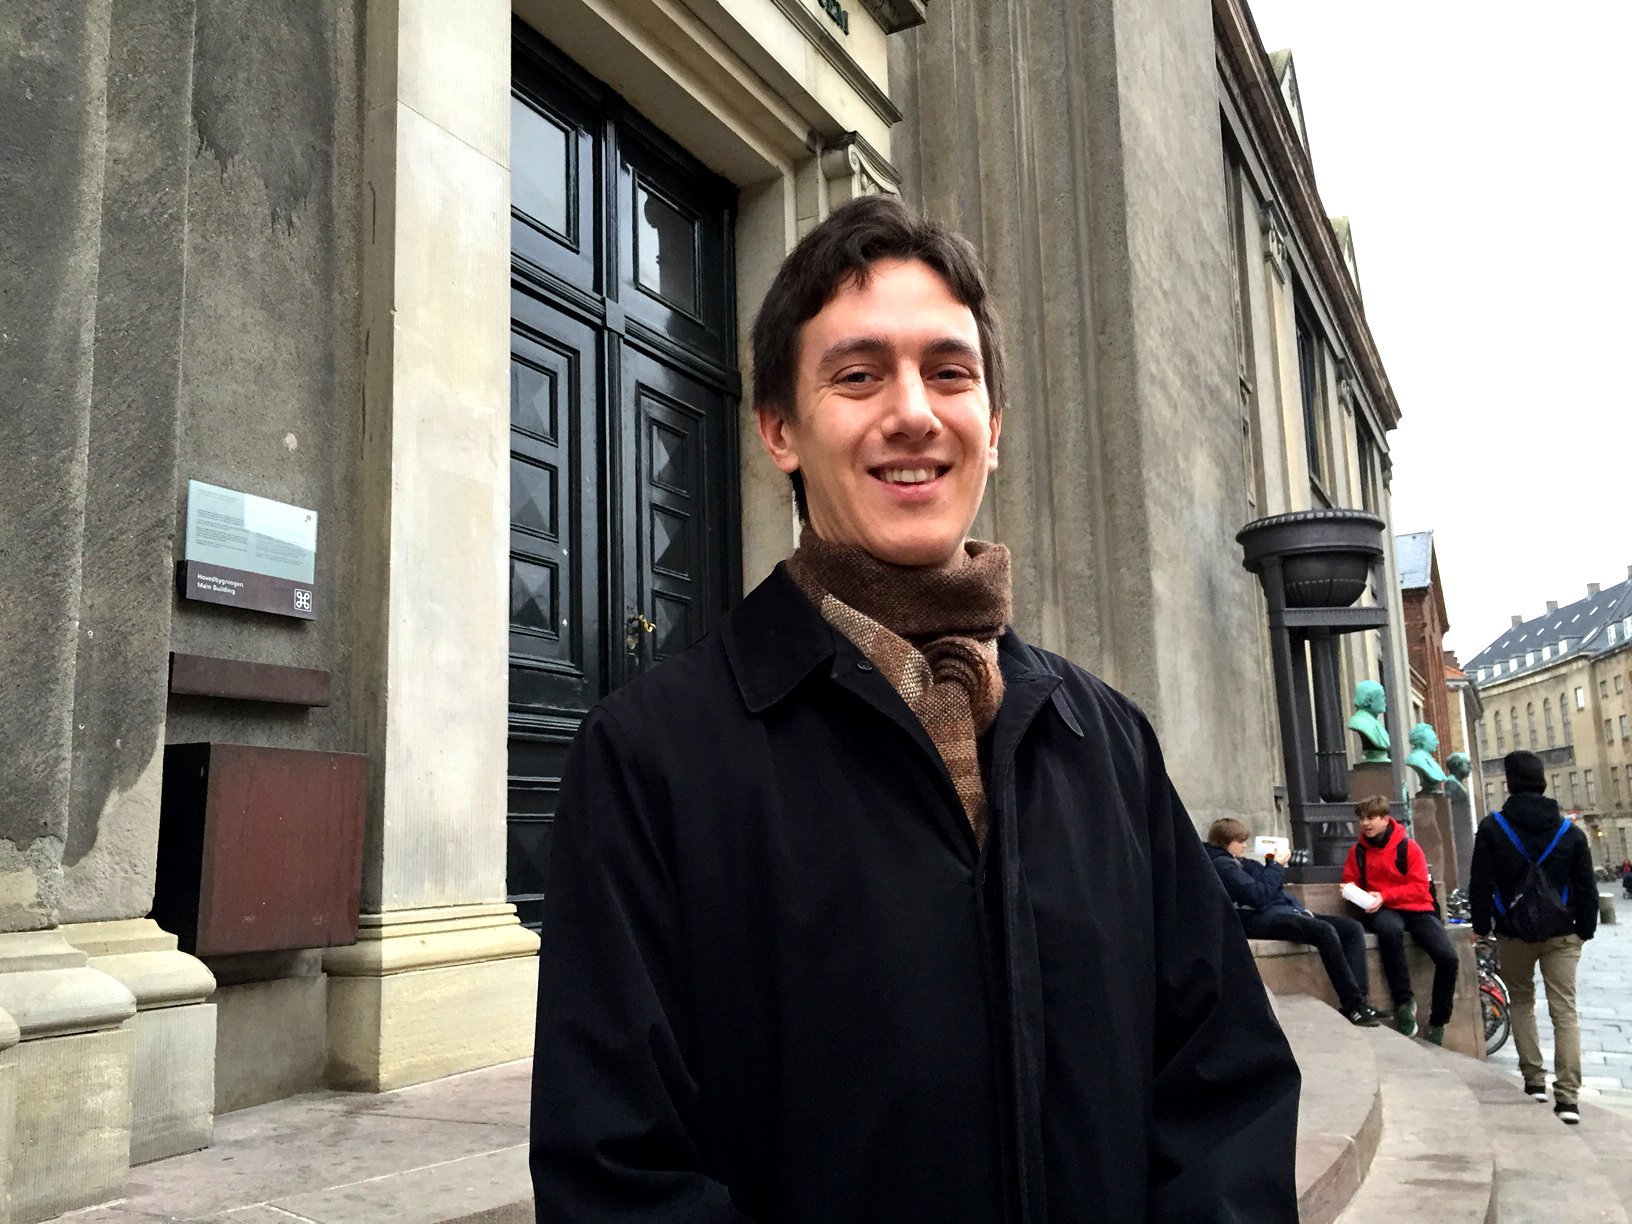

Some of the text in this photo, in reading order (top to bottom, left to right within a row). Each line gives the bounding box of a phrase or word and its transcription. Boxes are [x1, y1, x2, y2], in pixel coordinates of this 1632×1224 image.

[197, 573, 244, 588] Hovedbygningen
[197, 581, 236, 595] Main Building
